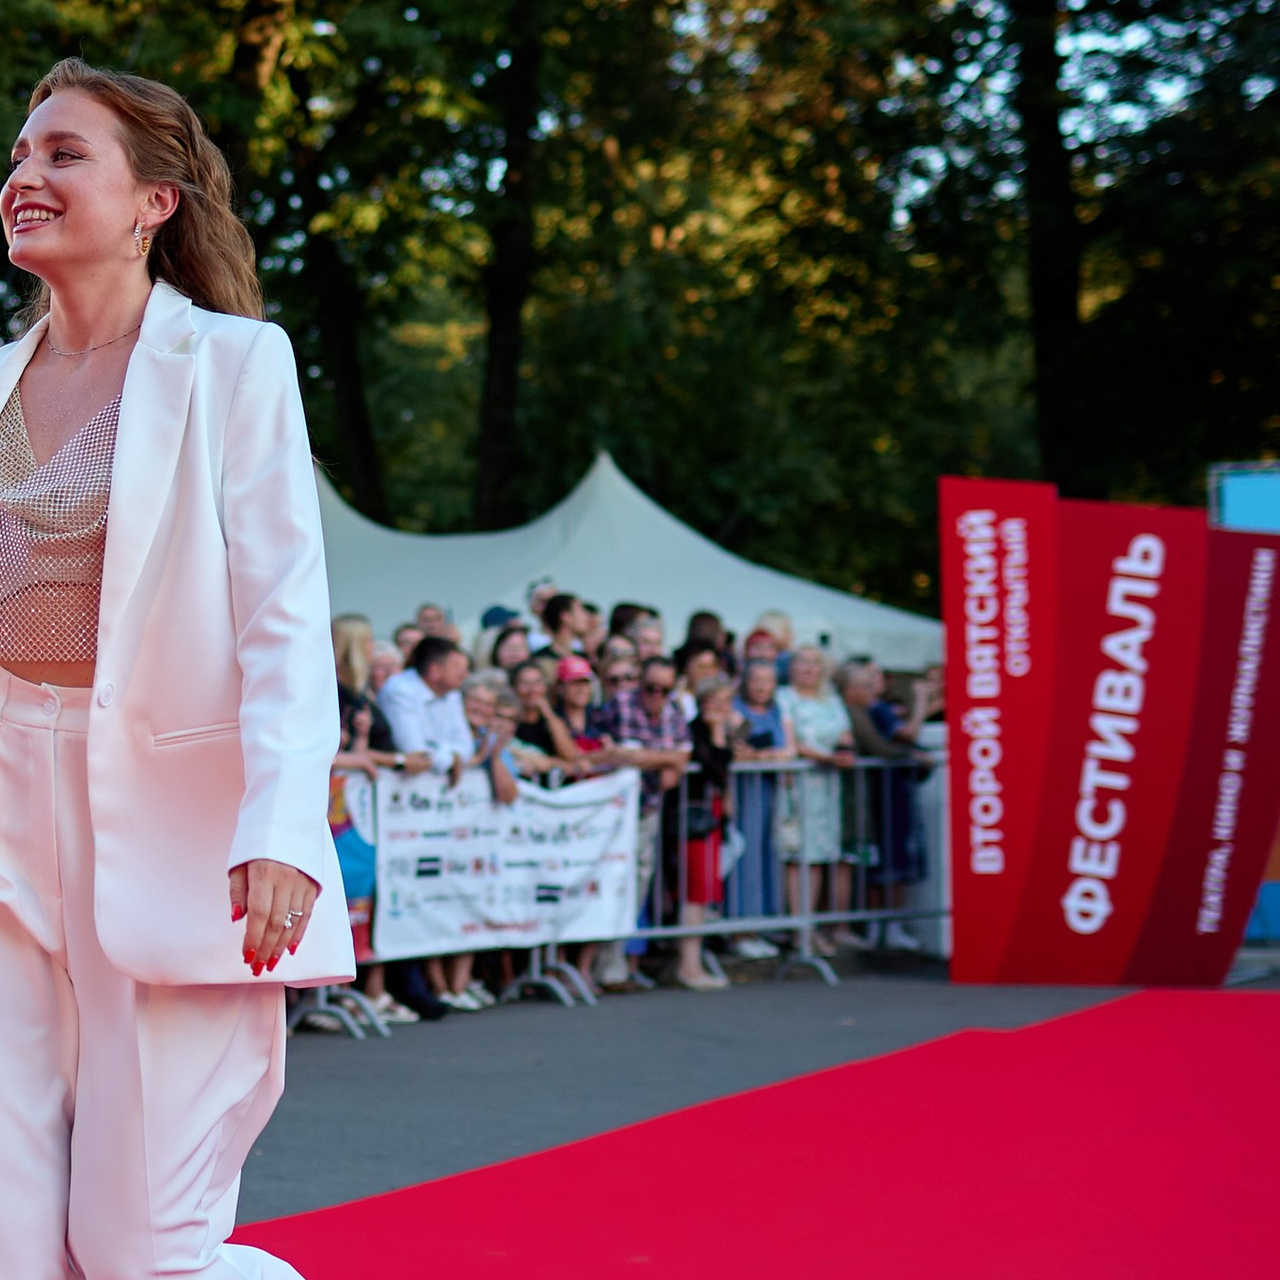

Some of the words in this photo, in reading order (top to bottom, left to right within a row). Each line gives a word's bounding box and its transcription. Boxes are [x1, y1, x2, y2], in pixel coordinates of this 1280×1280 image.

[956, 508, 1001, 699] ВЯТСКИЙ
[1001, 517, 1032, 677] ОТКРЫТЫЙ
[962, 707, 1005, 874] ВТОРОЙ
[1060, 532, 1167, 934] ФЕСТИВАЛЬ
